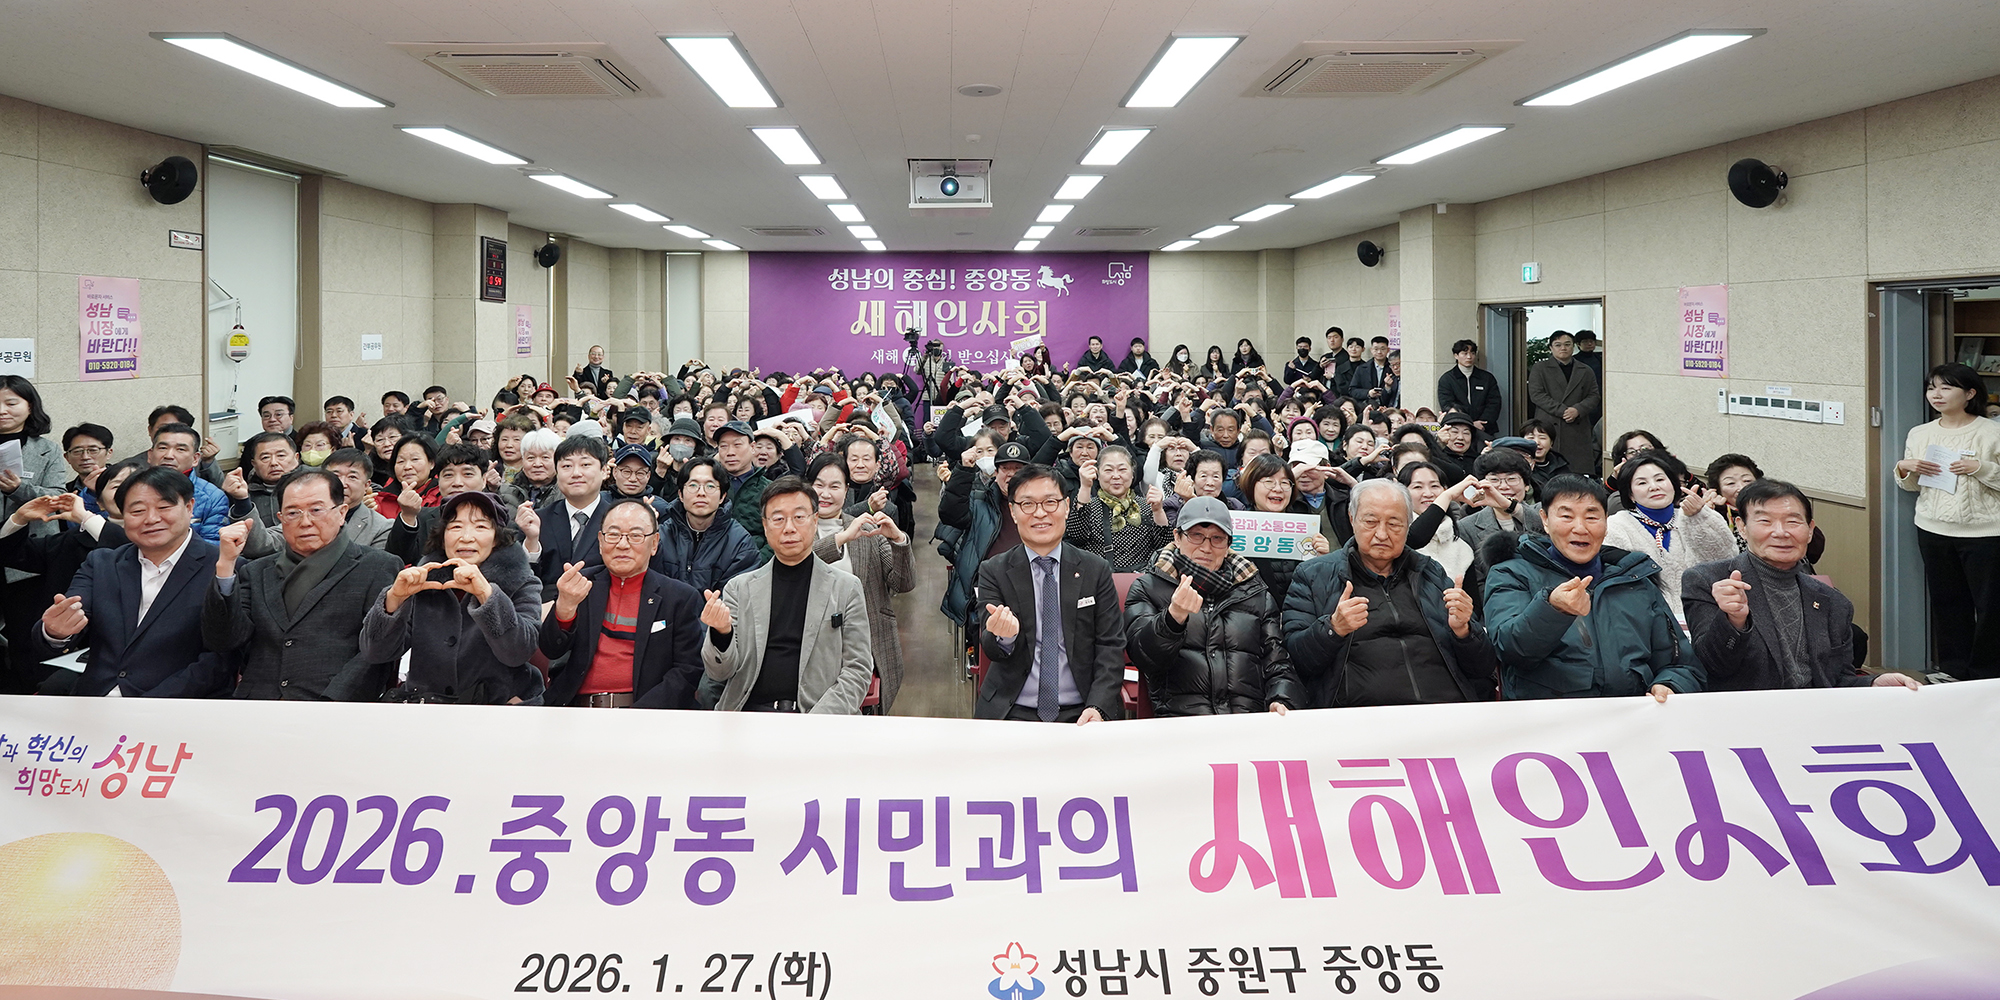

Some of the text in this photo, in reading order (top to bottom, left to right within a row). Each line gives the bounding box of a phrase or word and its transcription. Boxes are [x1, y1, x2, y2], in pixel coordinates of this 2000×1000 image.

[828, 268, 1032, 291] 성남의 중심! 중앙동
[86, 303, 113, 318] 성남
[850, 300, 1047, 337] 새해인사회
[1684, 309, 1704, 323] 성남
[88, 321, 128, 336] 시장에게
[1684, 325, 1716, 338] 시장에게
[87, 338, 138, 354] 바란다!!
[1684, 341, 1723, 354] 바란다!!
[0, 351, 31, 363] 공무원
[870, 348, 899, 364] 새해
[88, 360, 135, 371] 010-5920-0184
[1685, 360, 1722, 370] 010-5920-0184
[1231, 518, 1307, 534] 감과 소통으로
[0, 734, 88, 763] 과 혁신의
[92, 734, 194, 800] 성남
[14, 767, 90, 798] 희망도시
[1189, 742, 2000, 898] 새해인사회
[779, 796, 1139, 901] 시민과의
[514, 953, 631, 993] 2026.
[652, 954, 684, 993] 1.
[1052, 944, 1443, 998] 성남시 중원구 중앙동
